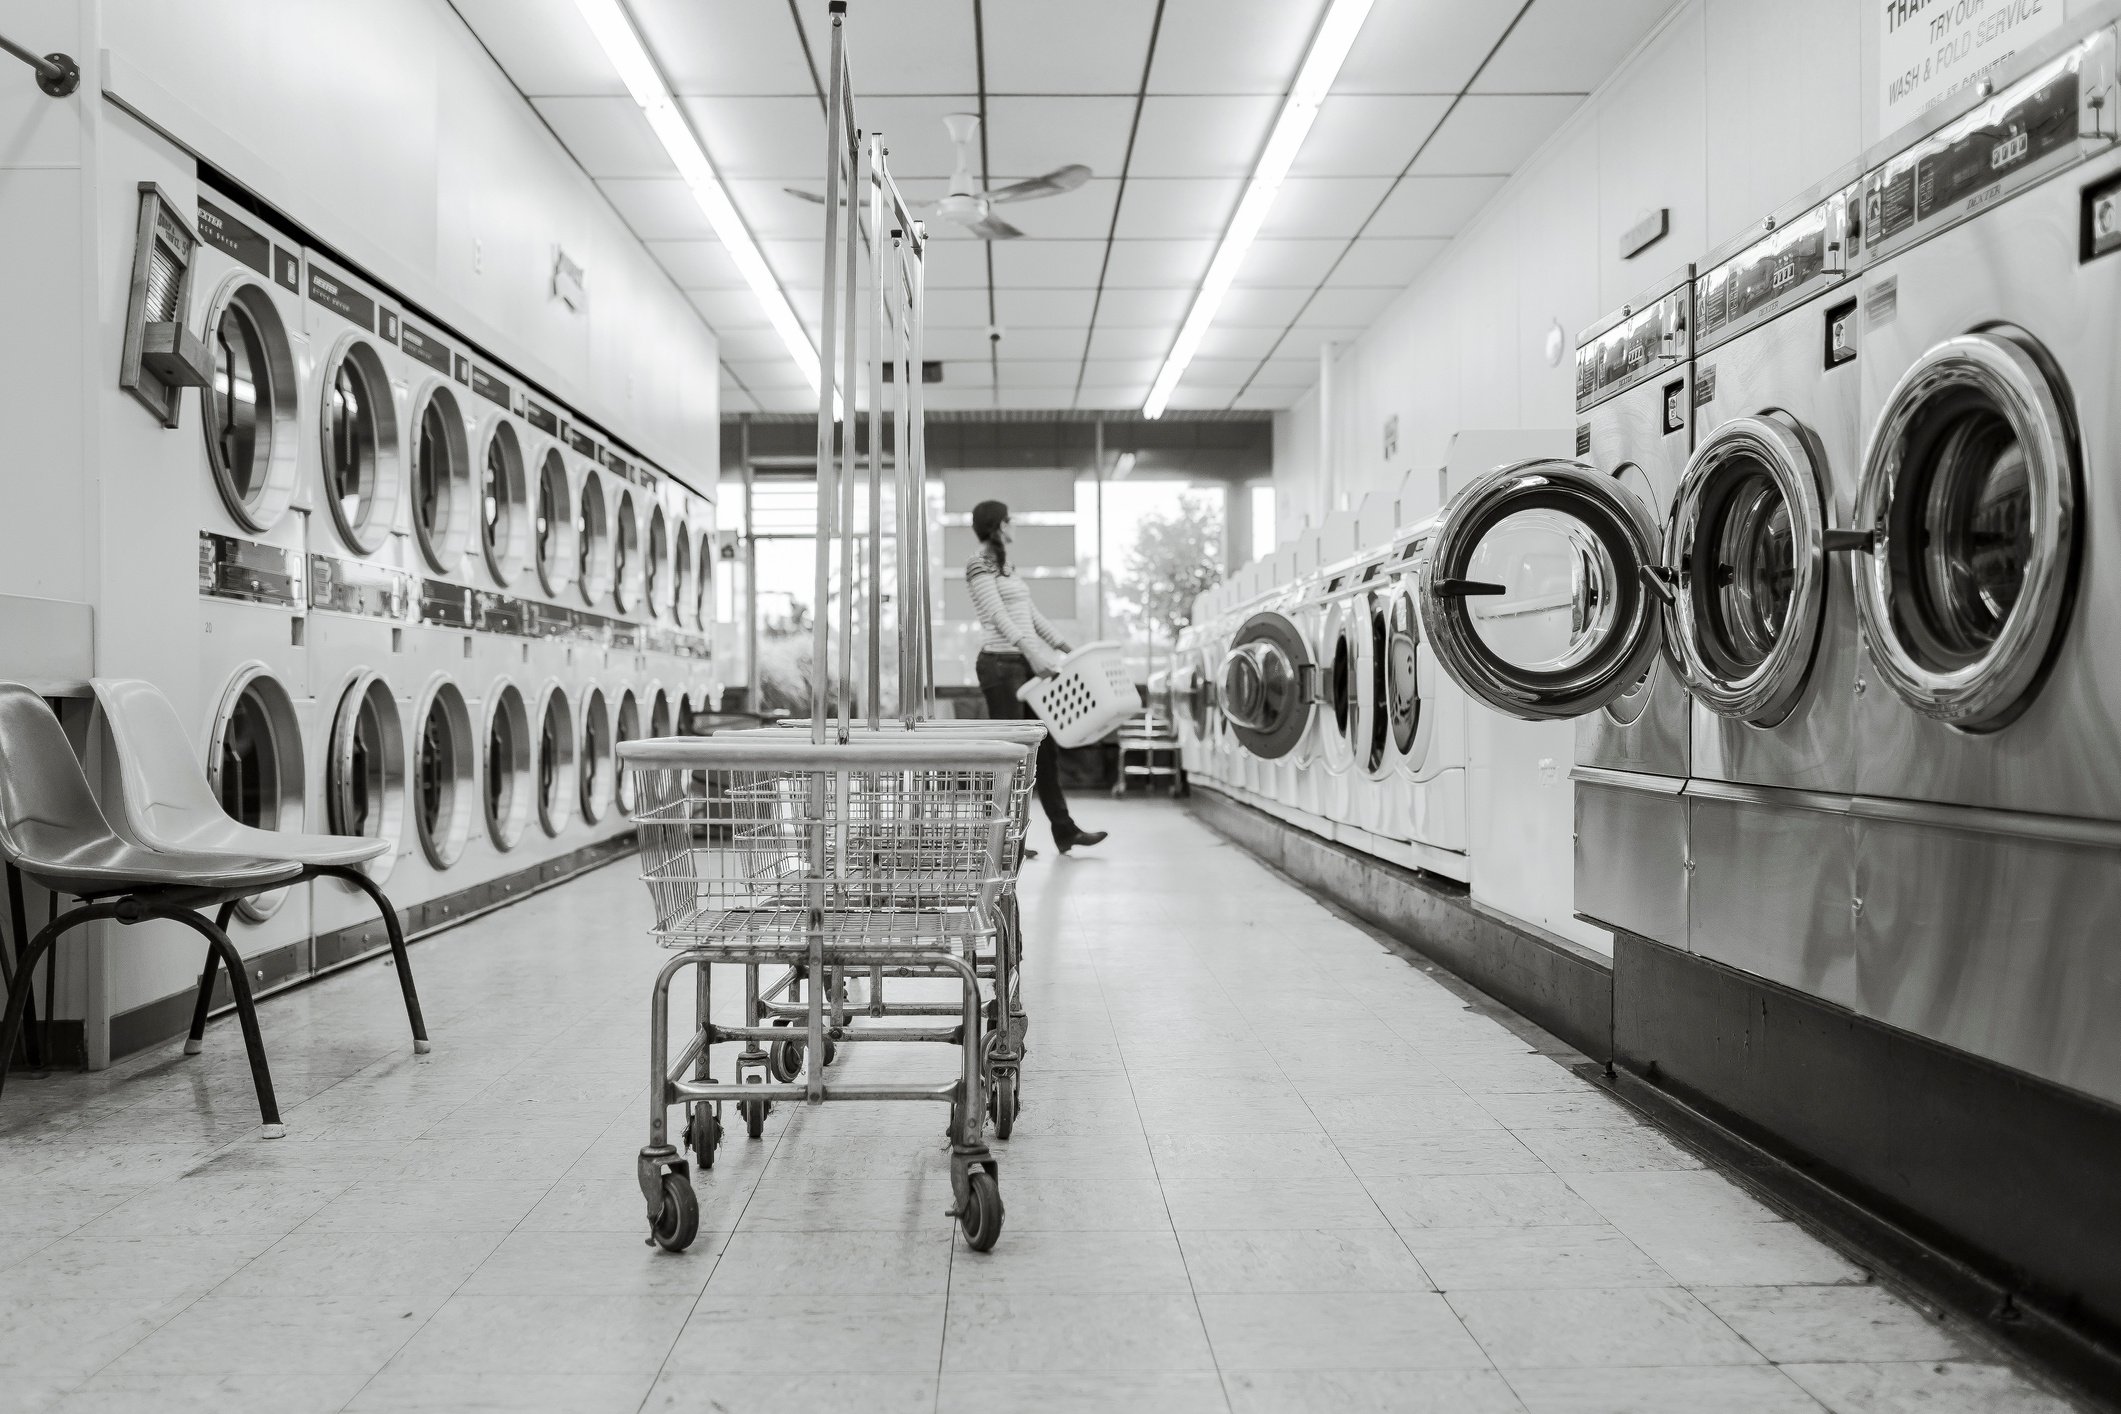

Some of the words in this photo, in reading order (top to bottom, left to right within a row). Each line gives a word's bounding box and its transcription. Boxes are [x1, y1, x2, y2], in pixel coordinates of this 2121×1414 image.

[1887, 0, 1932, 34] THA
[1930, 6, 1955, 44] TRY
[1889, 64, 1920, 106] WASH
[1923, 57, 1932, 83] &
[1936, 31, 1971, 75] FOLD
[1976, 0, 2042, 48] SERVICE
[204, 621, 213, 634] 20
